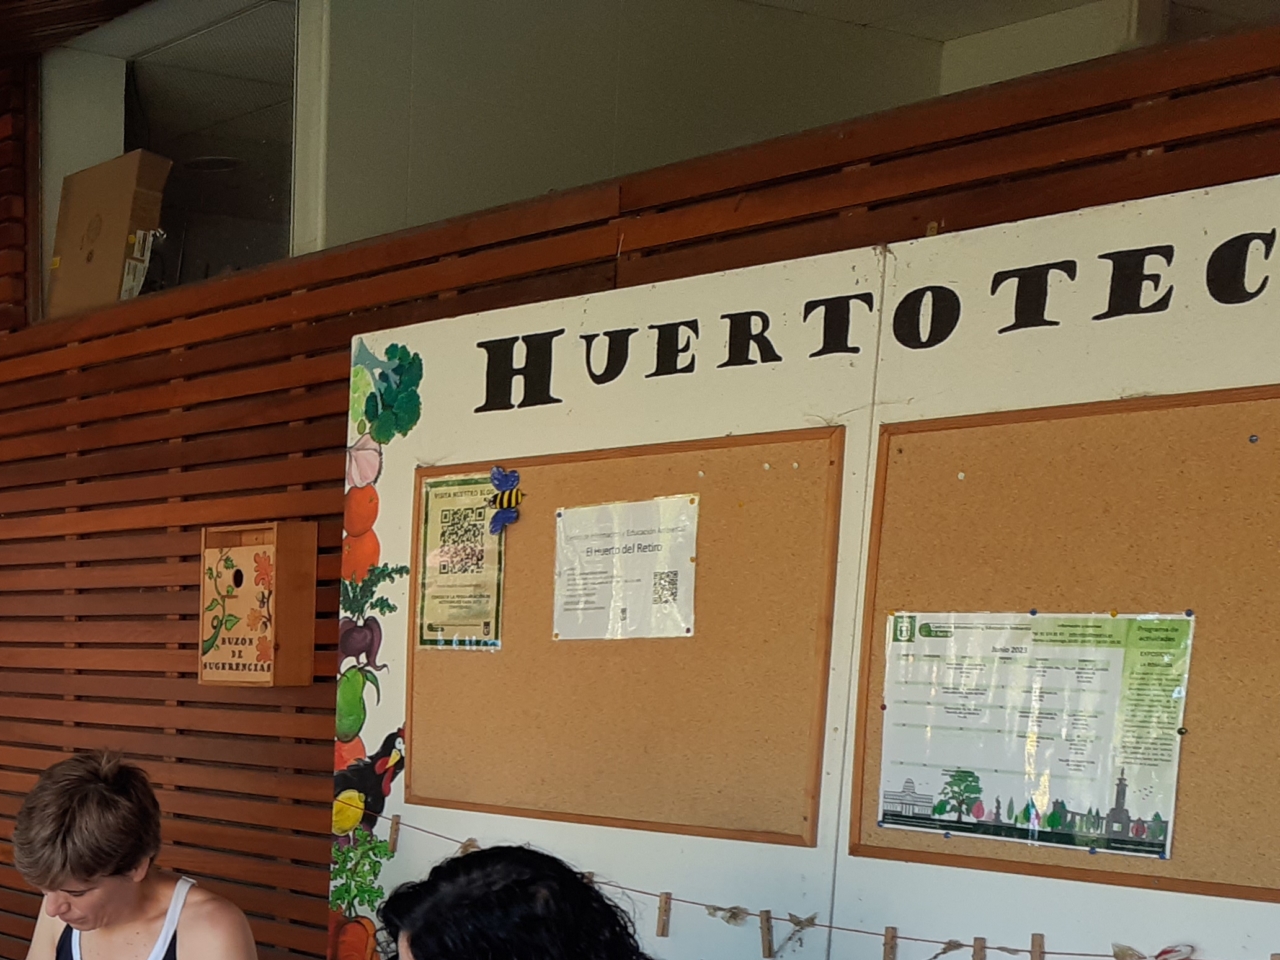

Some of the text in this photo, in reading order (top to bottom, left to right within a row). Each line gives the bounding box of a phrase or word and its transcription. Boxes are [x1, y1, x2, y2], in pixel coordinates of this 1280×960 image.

[474, 227, 1277, 414] HUERTOTEC
[585, 541, 663, 558] El Huerto del Retiro
[221, 635, 254, 646] BUZÓN
[231, 650, 244, 659] DE
[203, 662, 272, 673] SUGERENCIAS
